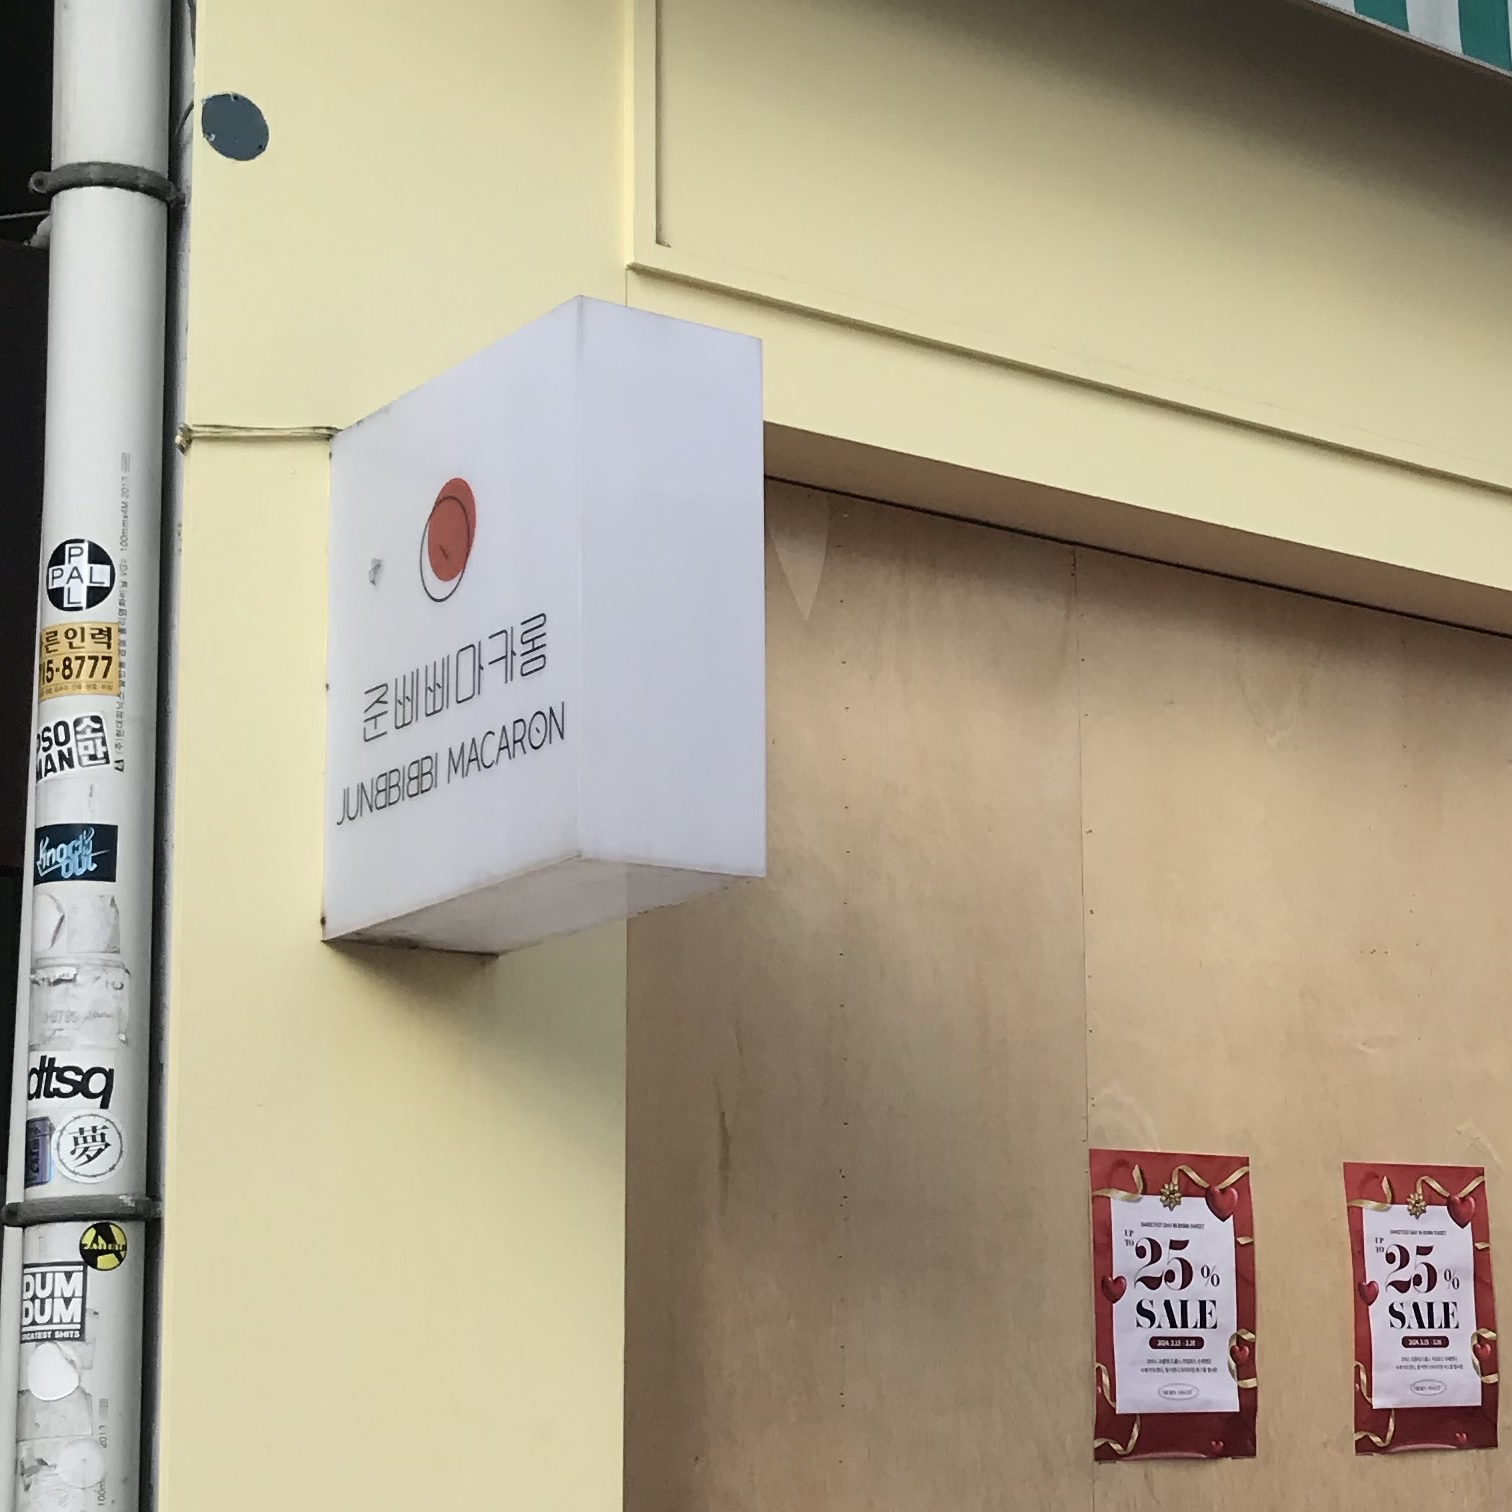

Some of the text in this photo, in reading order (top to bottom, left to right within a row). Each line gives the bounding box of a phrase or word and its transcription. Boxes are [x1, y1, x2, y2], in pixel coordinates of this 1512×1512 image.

[44, 626, 113, 653] 른인력
[447, 701, 565, 785] MACARON
[69, 1124, 112, 1168] 夢
[23, 1271, 84, 1300] DUM
[22, 1297, 83, 1326] DUM
[1135, 1299, 1218, 1330] SALE
[1388, 1302, 1460, 1329] SALE
